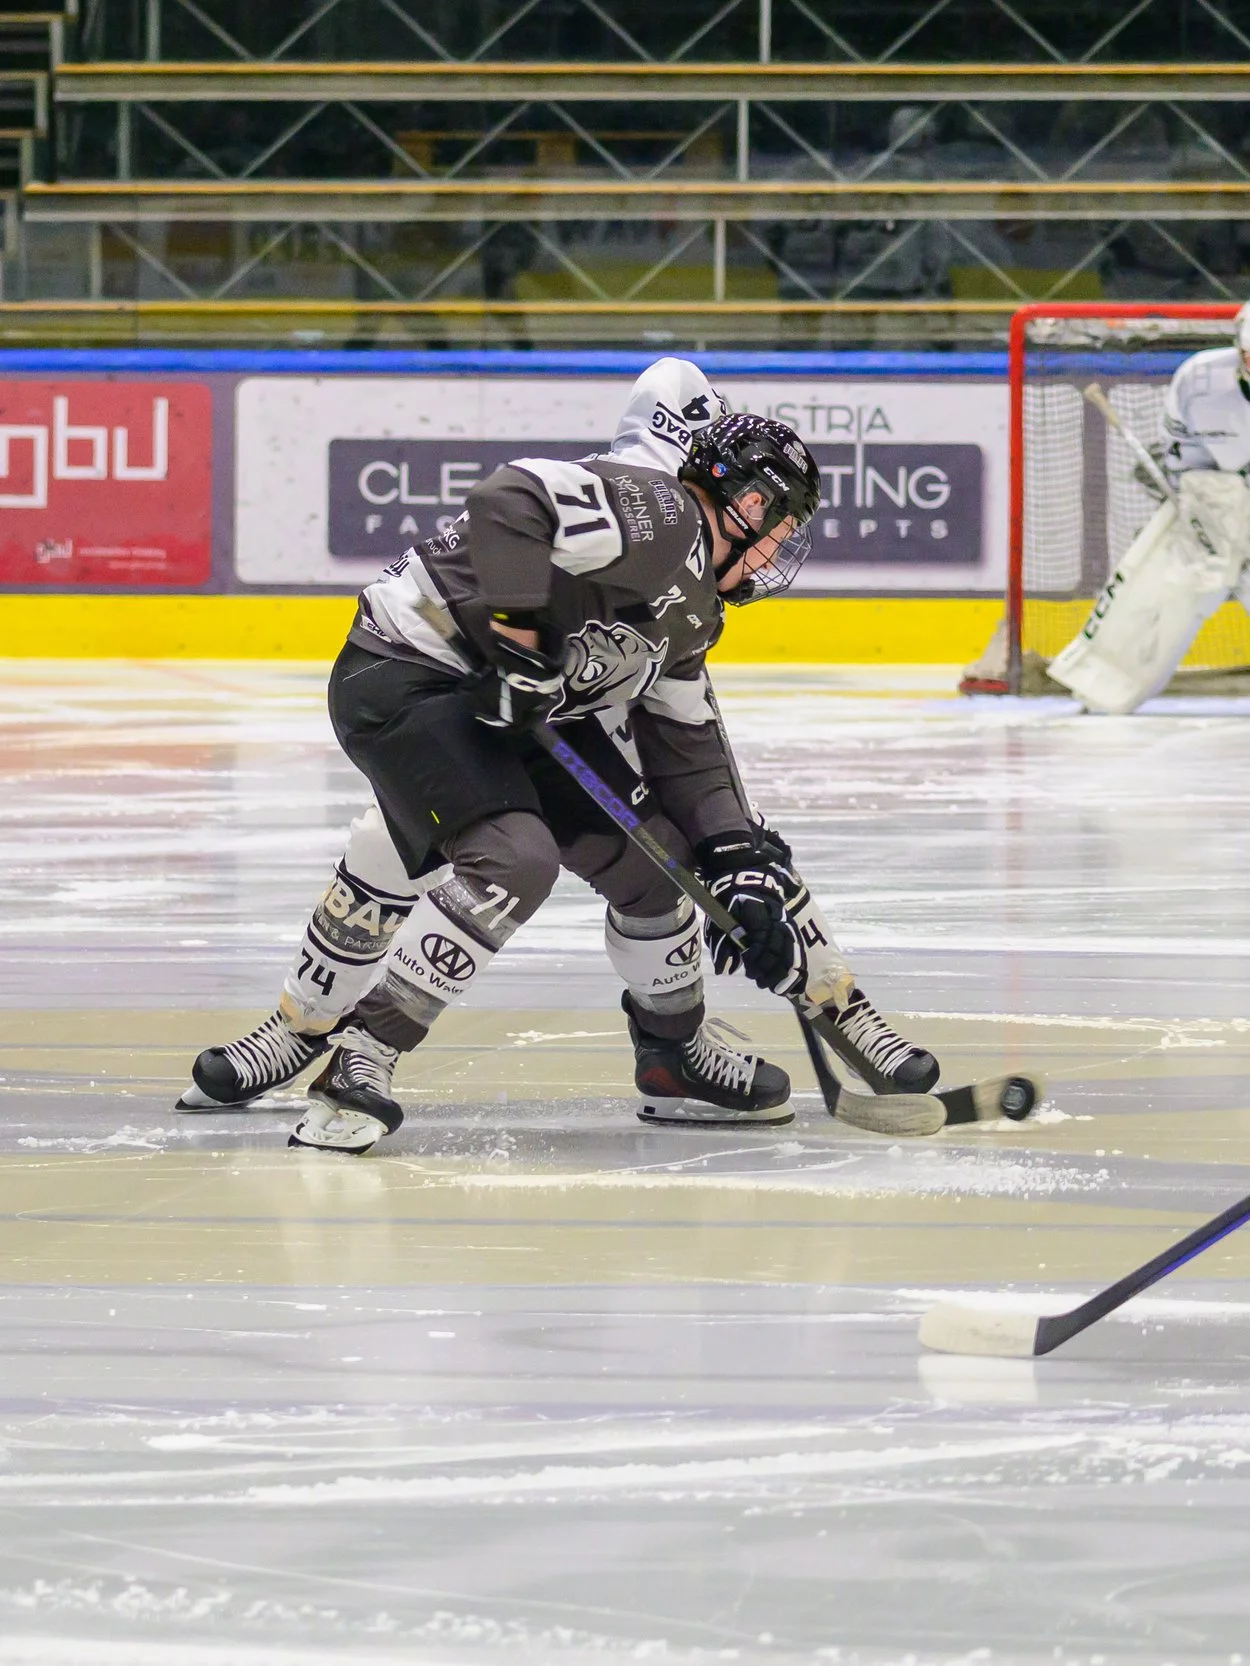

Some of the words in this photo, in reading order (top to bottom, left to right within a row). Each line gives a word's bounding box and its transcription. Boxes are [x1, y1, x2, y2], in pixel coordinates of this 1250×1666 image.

[722, 394, 893, 441] STRIA
[358, 460, 484, 505] CLE
[763, 467, 790, 492] CCM
[554, 484, 612, 538] 71
[615, 475, 654, 542] ROHNER
[648, 480, 678, 526] BULLDOGS
[815, 519, 949, 540] EPTS
[649, 585, 687, 620] 71
[710, 870, 784, 898] CCM
[470, 884, 520, 930] 71
[805, 918, 828, 950] 4
[297, 947, 337, 997] 74
[394, 947, 426, 976] Auto
[652, 970, 691, 988] Auto
